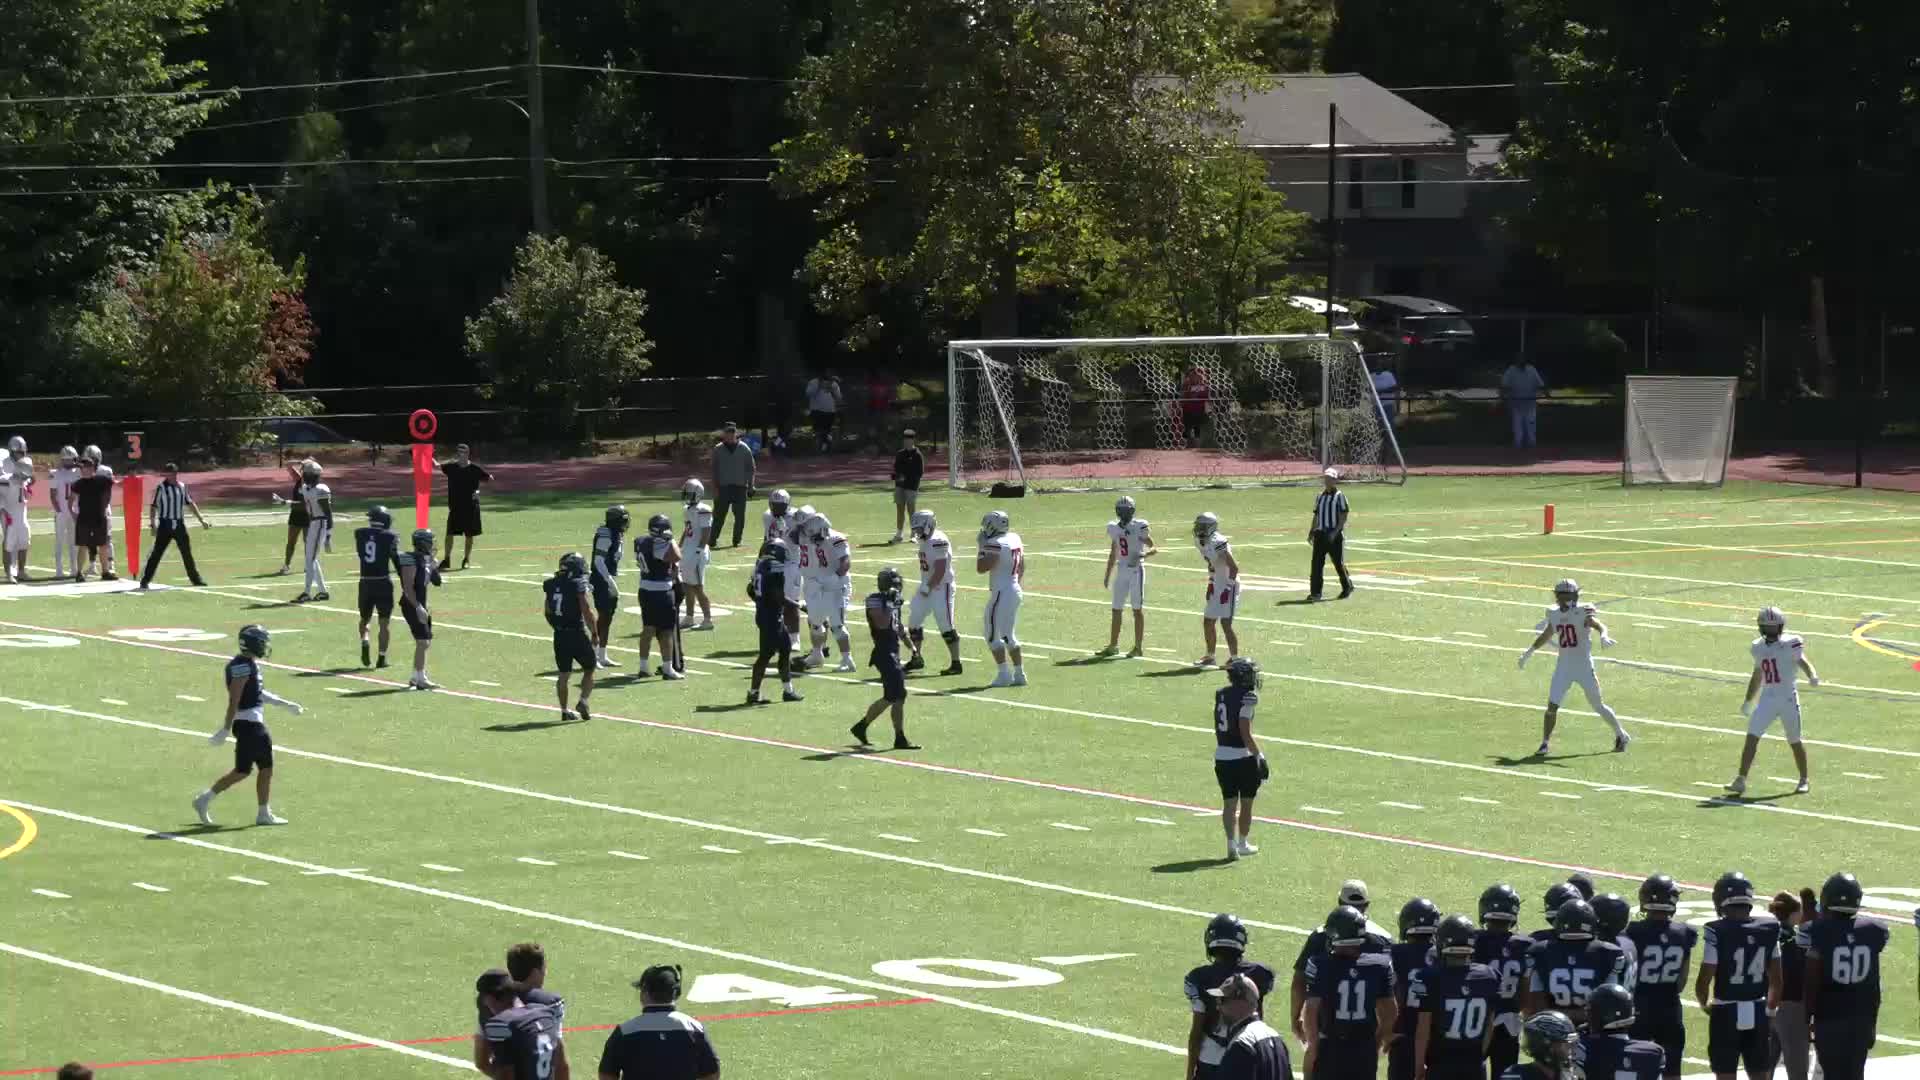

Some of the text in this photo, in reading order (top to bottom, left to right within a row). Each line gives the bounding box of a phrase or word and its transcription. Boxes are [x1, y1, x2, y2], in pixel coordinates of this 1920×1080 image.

[127, 434, 142, 459] 3
[364, 541, 376, 563] 9
[1119, 536, 1129, 557] 9
[553, 593, 564, 616] 7
[1556, 624, 1578, 648] 20
[1761, 658, 1780, 684] 81
[1217, 702, 1229, 732] 3
[1640, 945, 1684, 984] 22
[1730, 946, 1766, 984] 14
[1832, 945, 1871, 984] 60
[1335, 980, 1367, 1020] 11
[1549, 968, 1597, 1006] 65
[1445, 998, 1487, 1040] 70
[536, 1034, 553, 1078] 8
